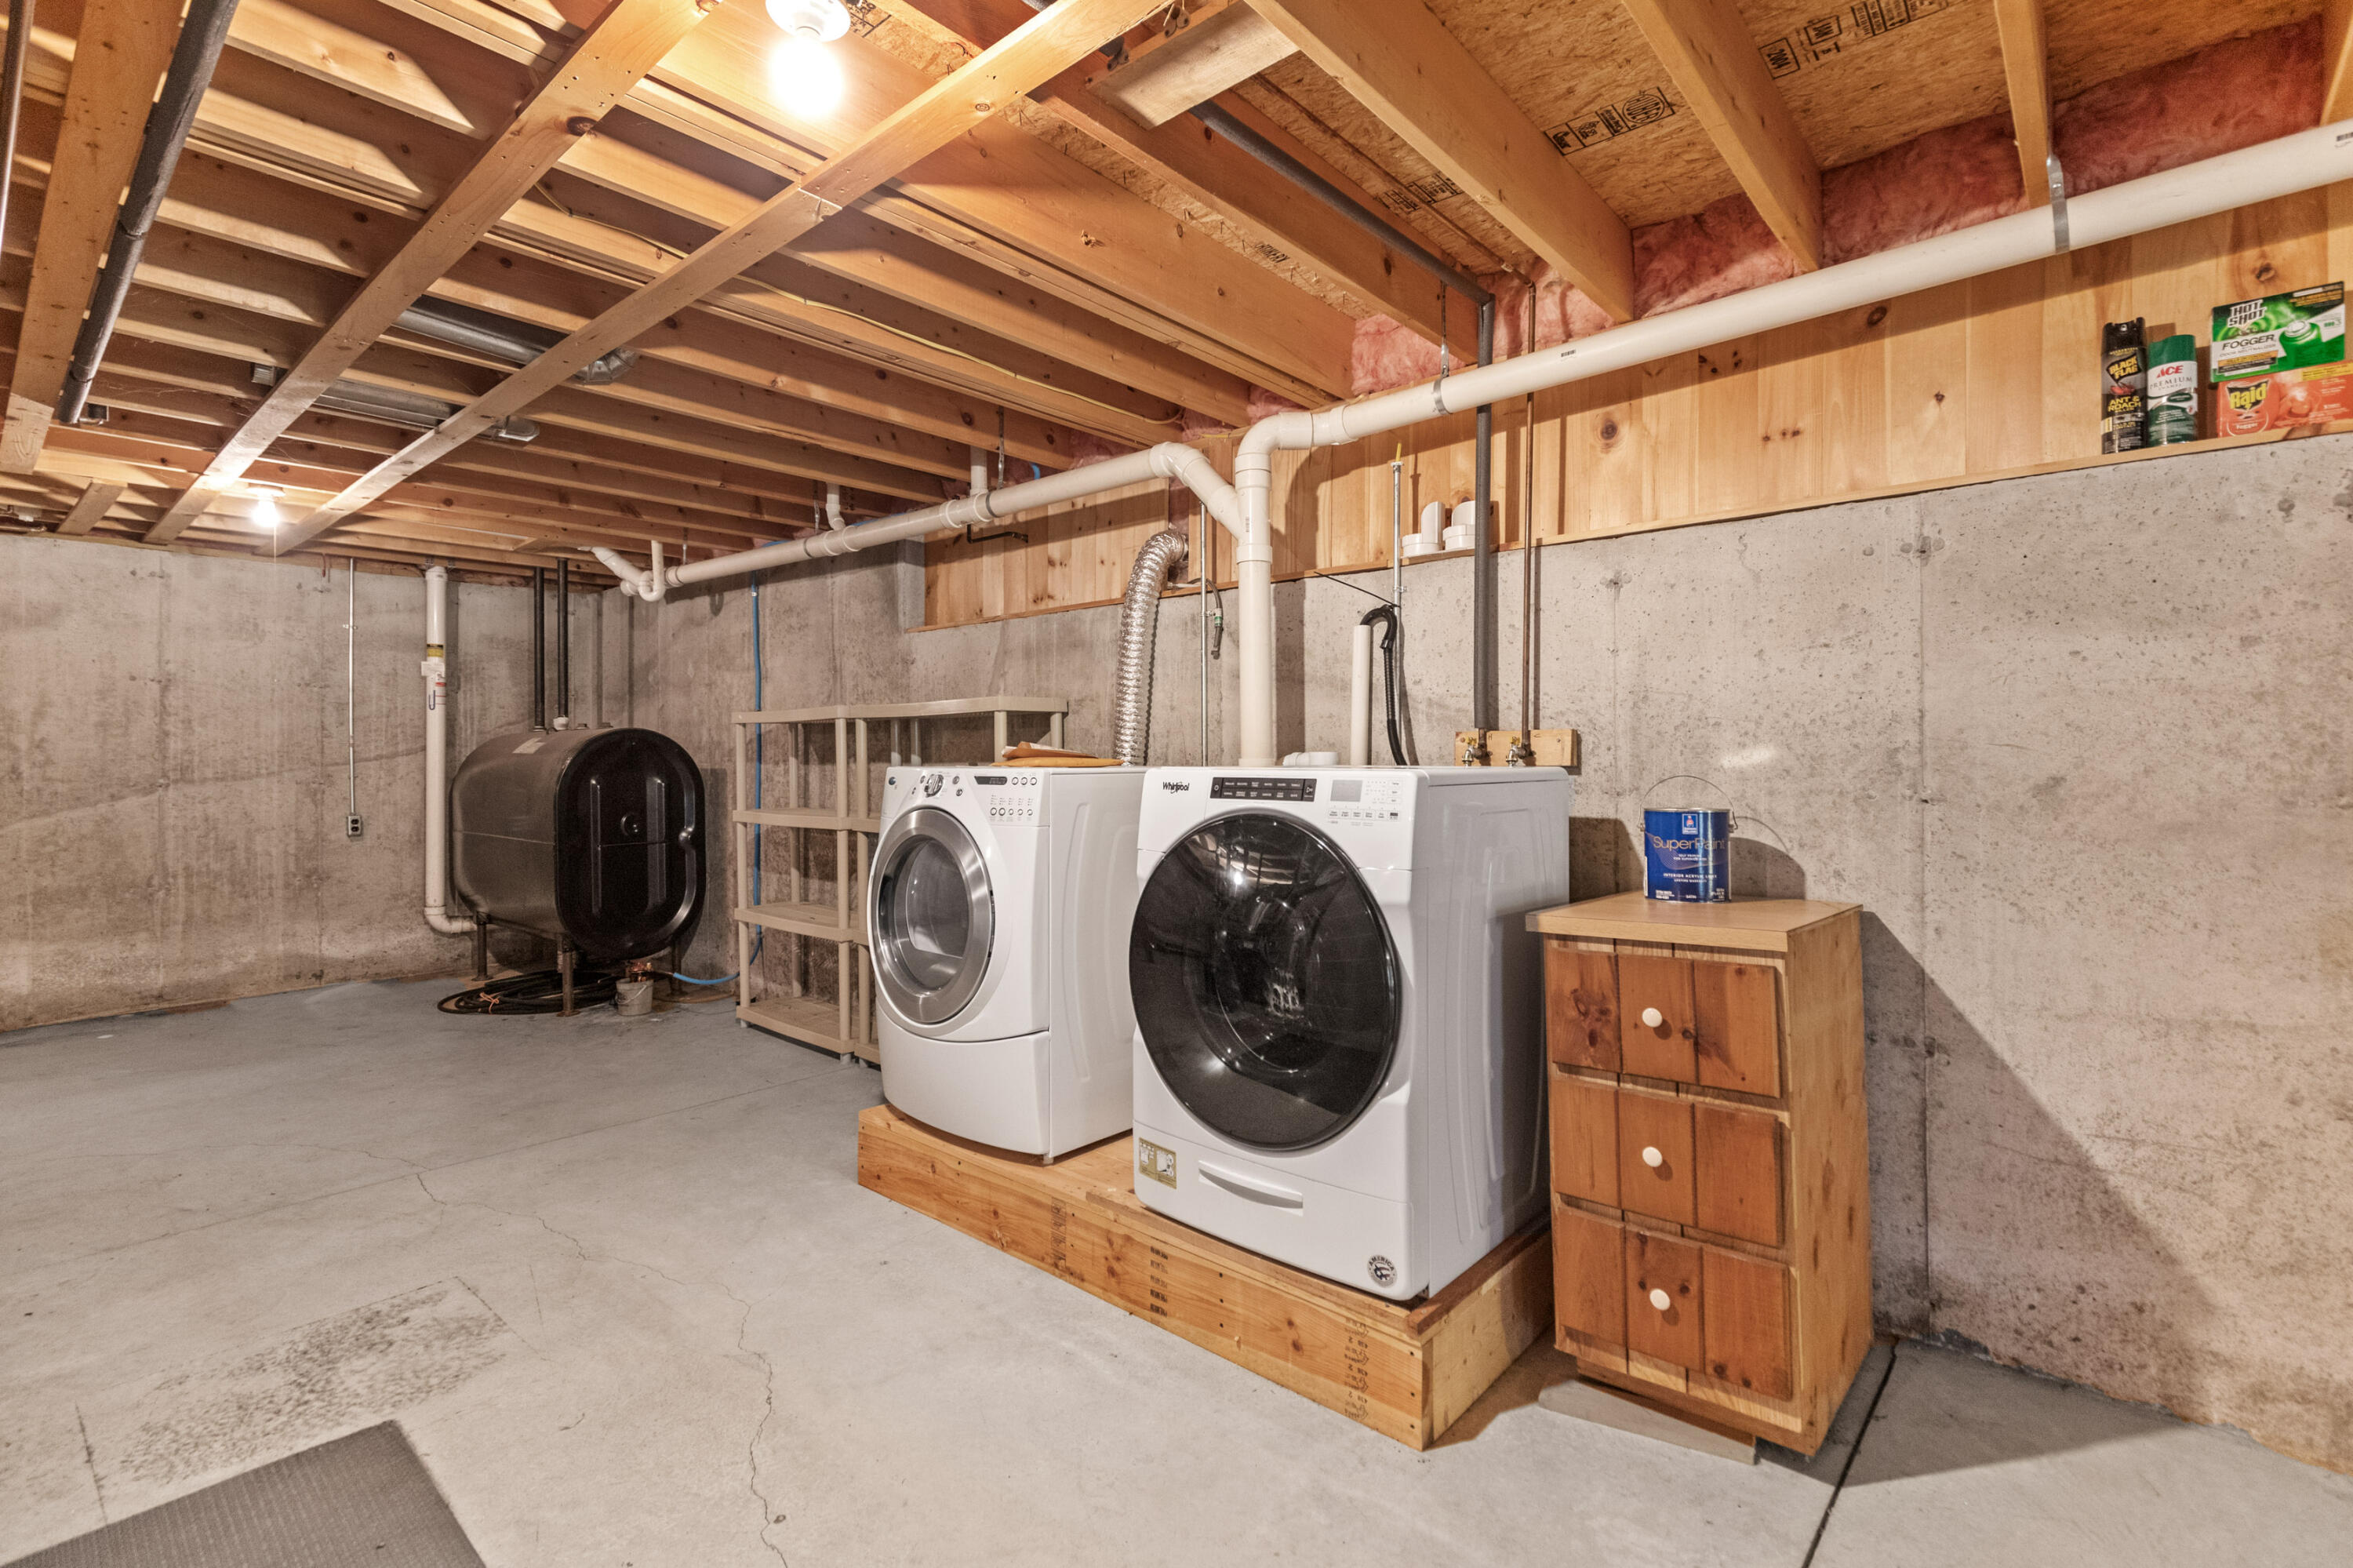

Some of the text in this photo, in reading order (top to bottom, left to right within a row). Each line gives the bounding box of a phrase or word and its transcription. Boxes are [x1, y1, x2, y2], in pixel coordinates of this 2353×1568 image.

[1812, 22, 1835, 39] JAN
[1766, 49, 1791, 69] 2004
[1625, 96, 1662, 123] HUBER
[2231, 300, 2262, 317] HOT
[2228, 308, 2266, 327] SHOT
[2222, 334, 2275, 351] FOGGER
[2110, 355, 2137, 375] BLACK
[2114, 365, 2138, 380] FLAG
[2156, 365, 2184, 379] ACE
[2150, 377, 2192, 390] PREMIUM
[2110, 396, 2131, 406] ANT
[2230, 382, 2267, 409] Raid
[2108, 401, 2141, 412] ROACH
[1162, 780, 1191, 794] Whirlpool
[1653, 836, 1726, 851] SuperPaint
[1369, 1256, 1395, 1271] AMERICA
